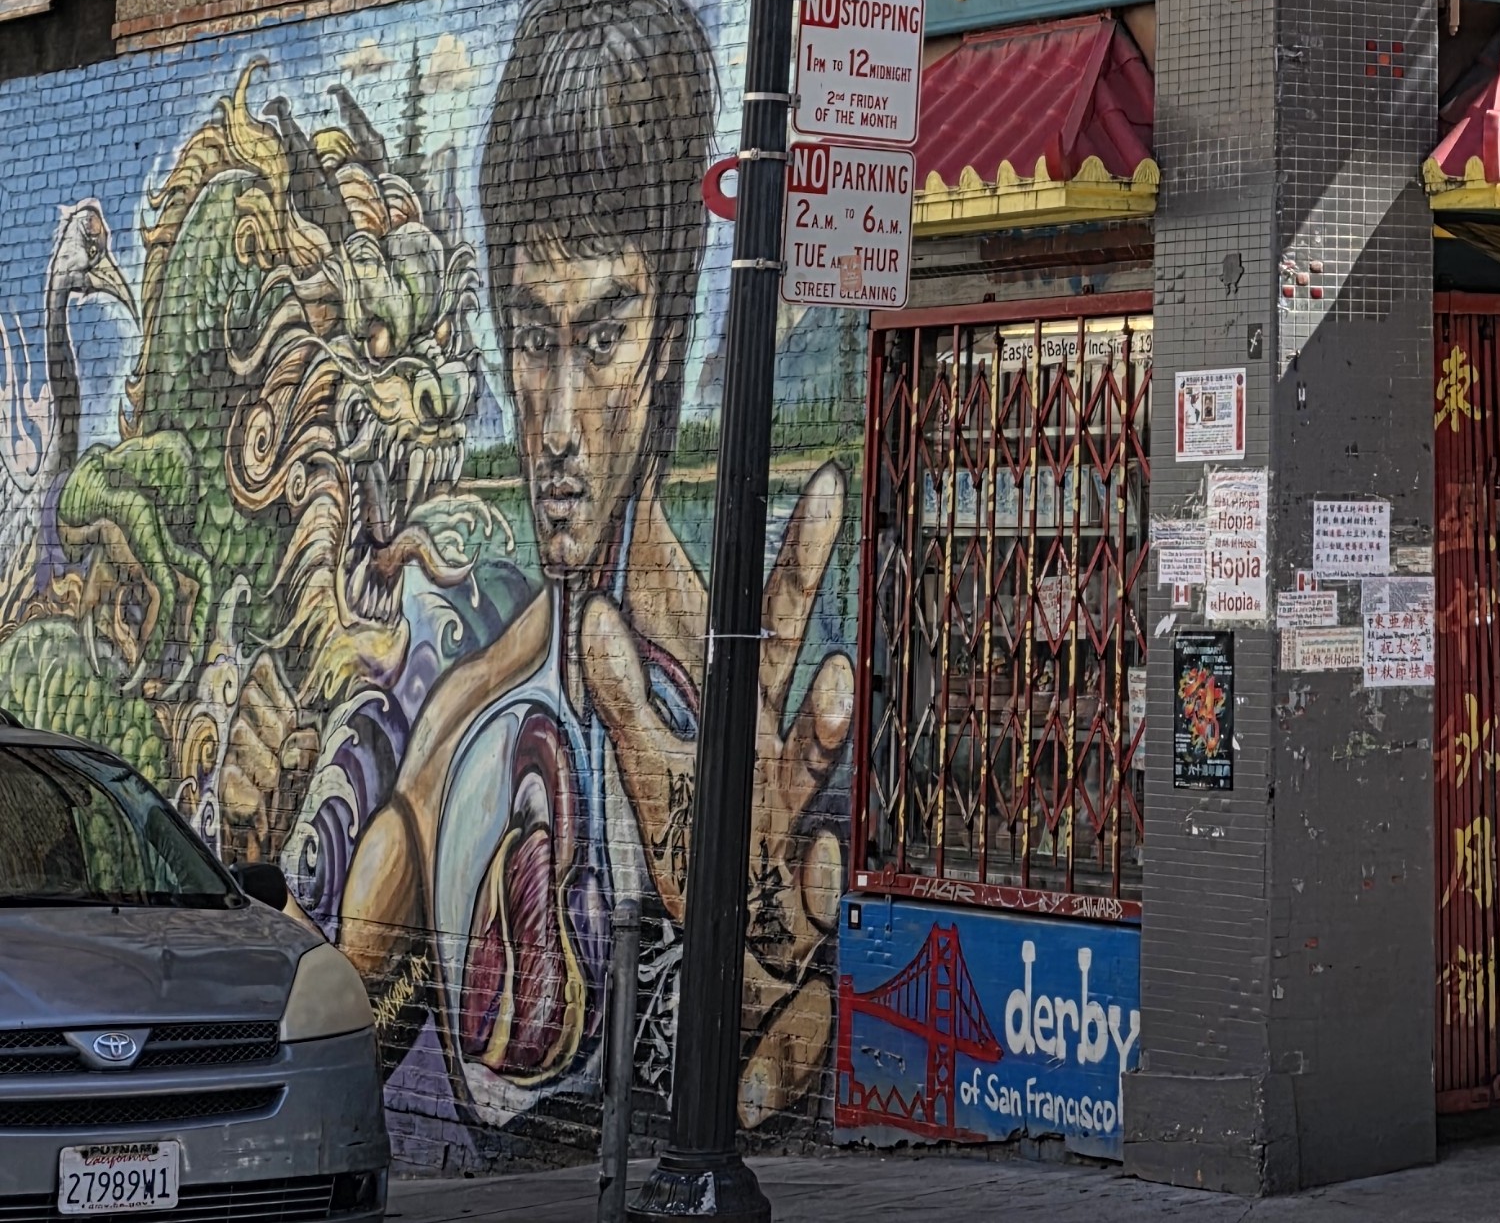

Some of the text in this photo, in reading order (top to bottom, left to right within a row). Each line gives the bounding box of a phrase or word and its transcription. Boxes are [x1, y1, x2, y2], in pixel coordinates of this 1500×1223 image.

[833, 60, 843, 72] TO
[827, 91, 889, 111] 2nd FRIDAY
[815, 107, 898, 129] OF THE MONTH
[792, 148, 909, 195] NO PARKING
[845, 208, 855, 220] TO
[794, 243, 828, 269] TUE
[854, 245, 899, 273] THUR
[795, 281, 836, 298] STREET
[1002, 342, 1047, 362] Easten
[1218, 511, 1254, 535] Hopia
[1211, 551, 1262, 586] Hopia
[1218, 591, 1254, 614] Hopia
[1334, 653, 1360, 667] Hopia
[1005, 940, 1140, 1125] derby
[960, 1067, 1116, 1132] of San Francisco
[90, 1144, 151, 1155] PUTNAM
[66, 1167, 170, 1204] 27989W1
